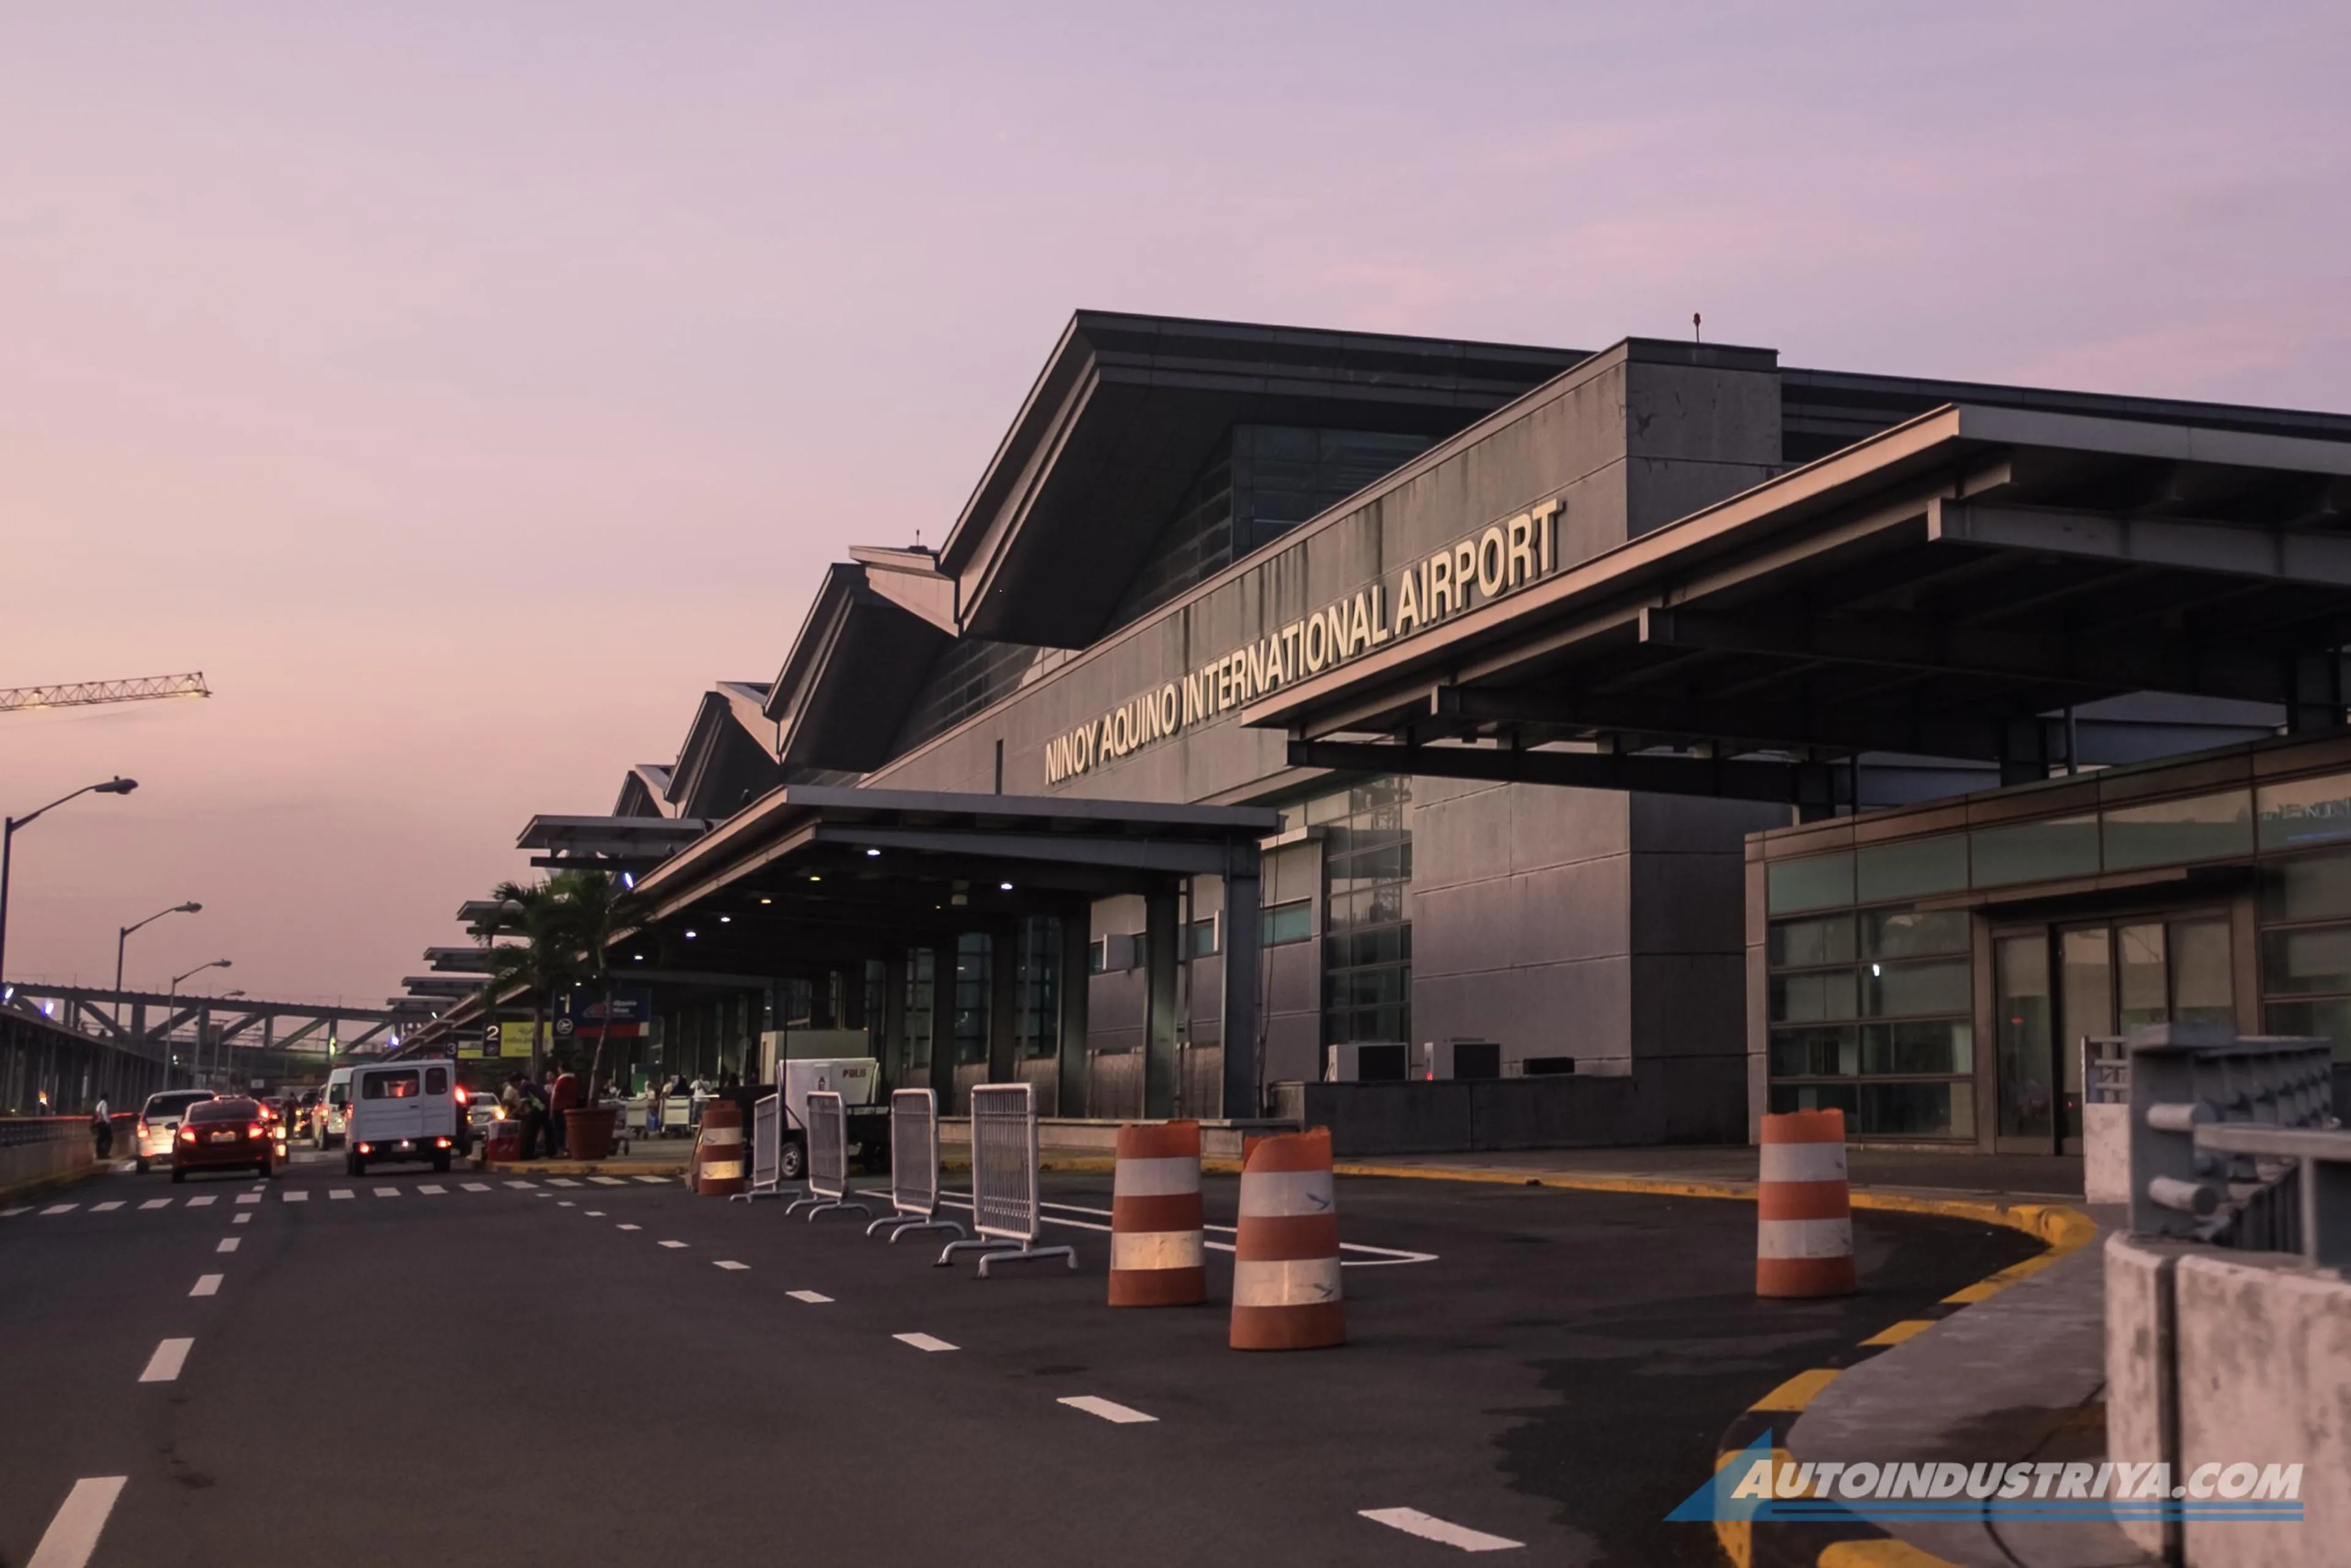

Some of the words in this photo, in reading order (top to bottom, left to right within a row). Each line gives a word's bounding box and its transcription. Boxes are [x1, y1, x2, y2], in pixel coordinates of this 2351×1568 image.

[1045, 720, 1098, 785] NINOY
[1101, 683, 1177, 761] AQUINO
[1182, 585, 1388, 727] INTERNATIONAL
[1395, 498, 1558, 635] AIRPORT
[559, 993, 571, 1014] 1
[486, 1025, 499, 1040] 2
[446, 1042, 457, 1055] 3
